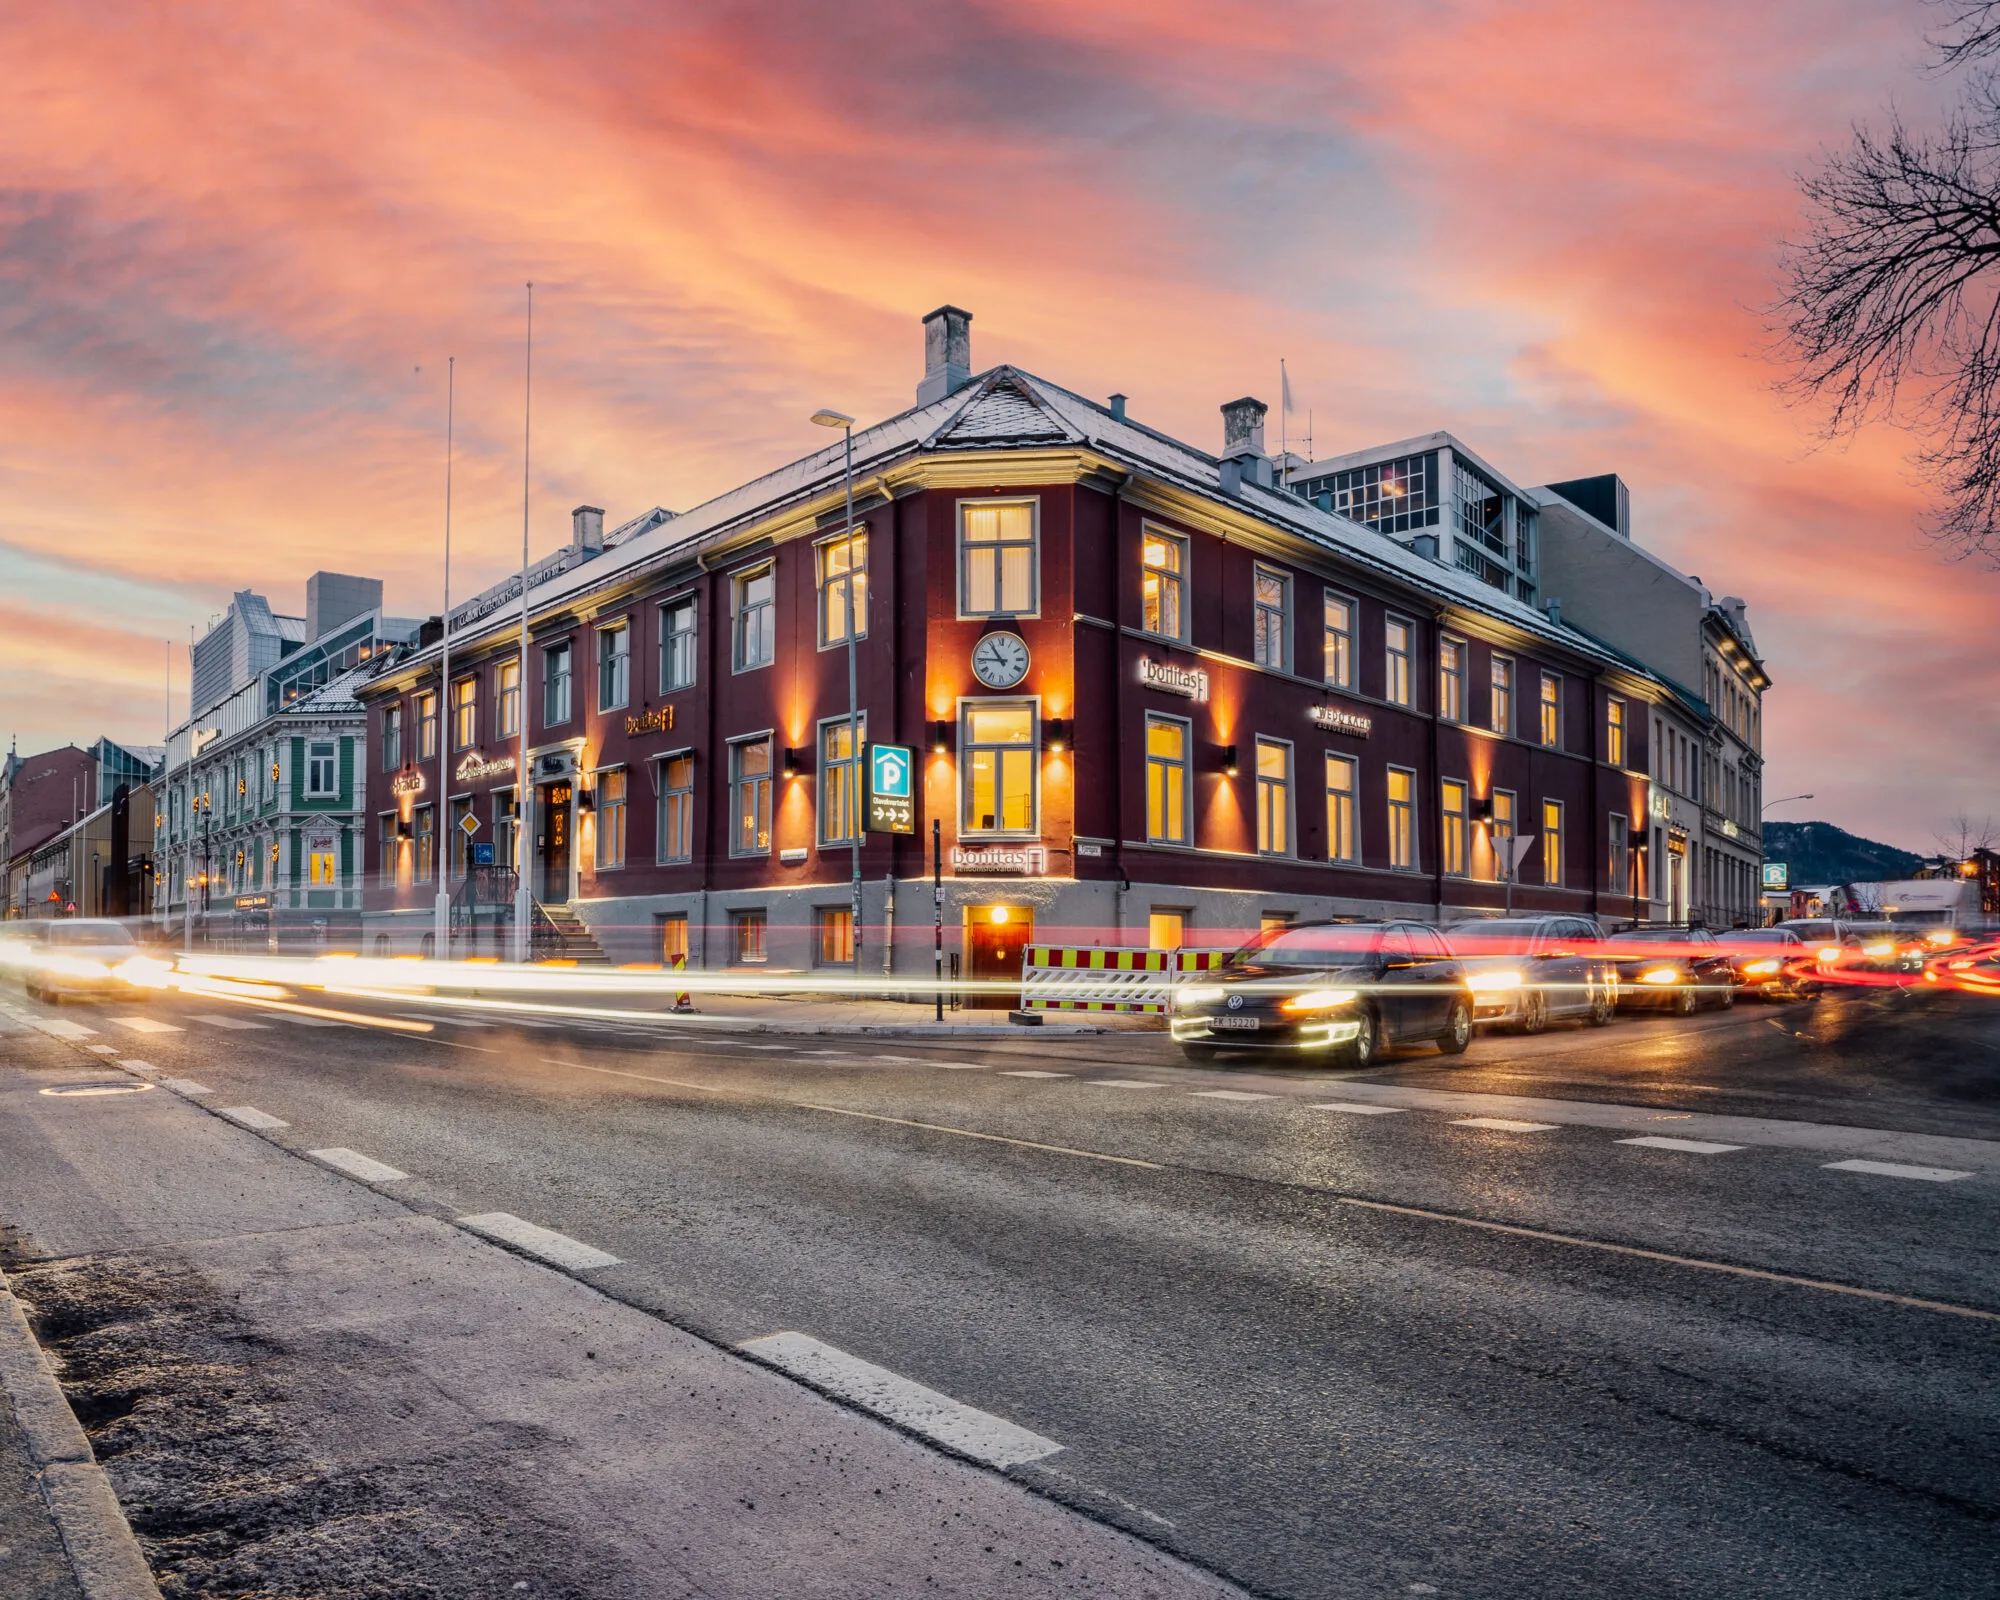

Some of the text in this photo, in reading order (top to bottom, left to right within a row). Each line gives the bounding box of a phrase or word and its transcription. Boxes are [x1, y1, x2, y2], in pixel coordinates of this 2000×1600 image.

[883, 762, 901, 791] P
[953, 848, 1025, 864] bonitas
[1228, 1018, 1256, 1028] 15220
